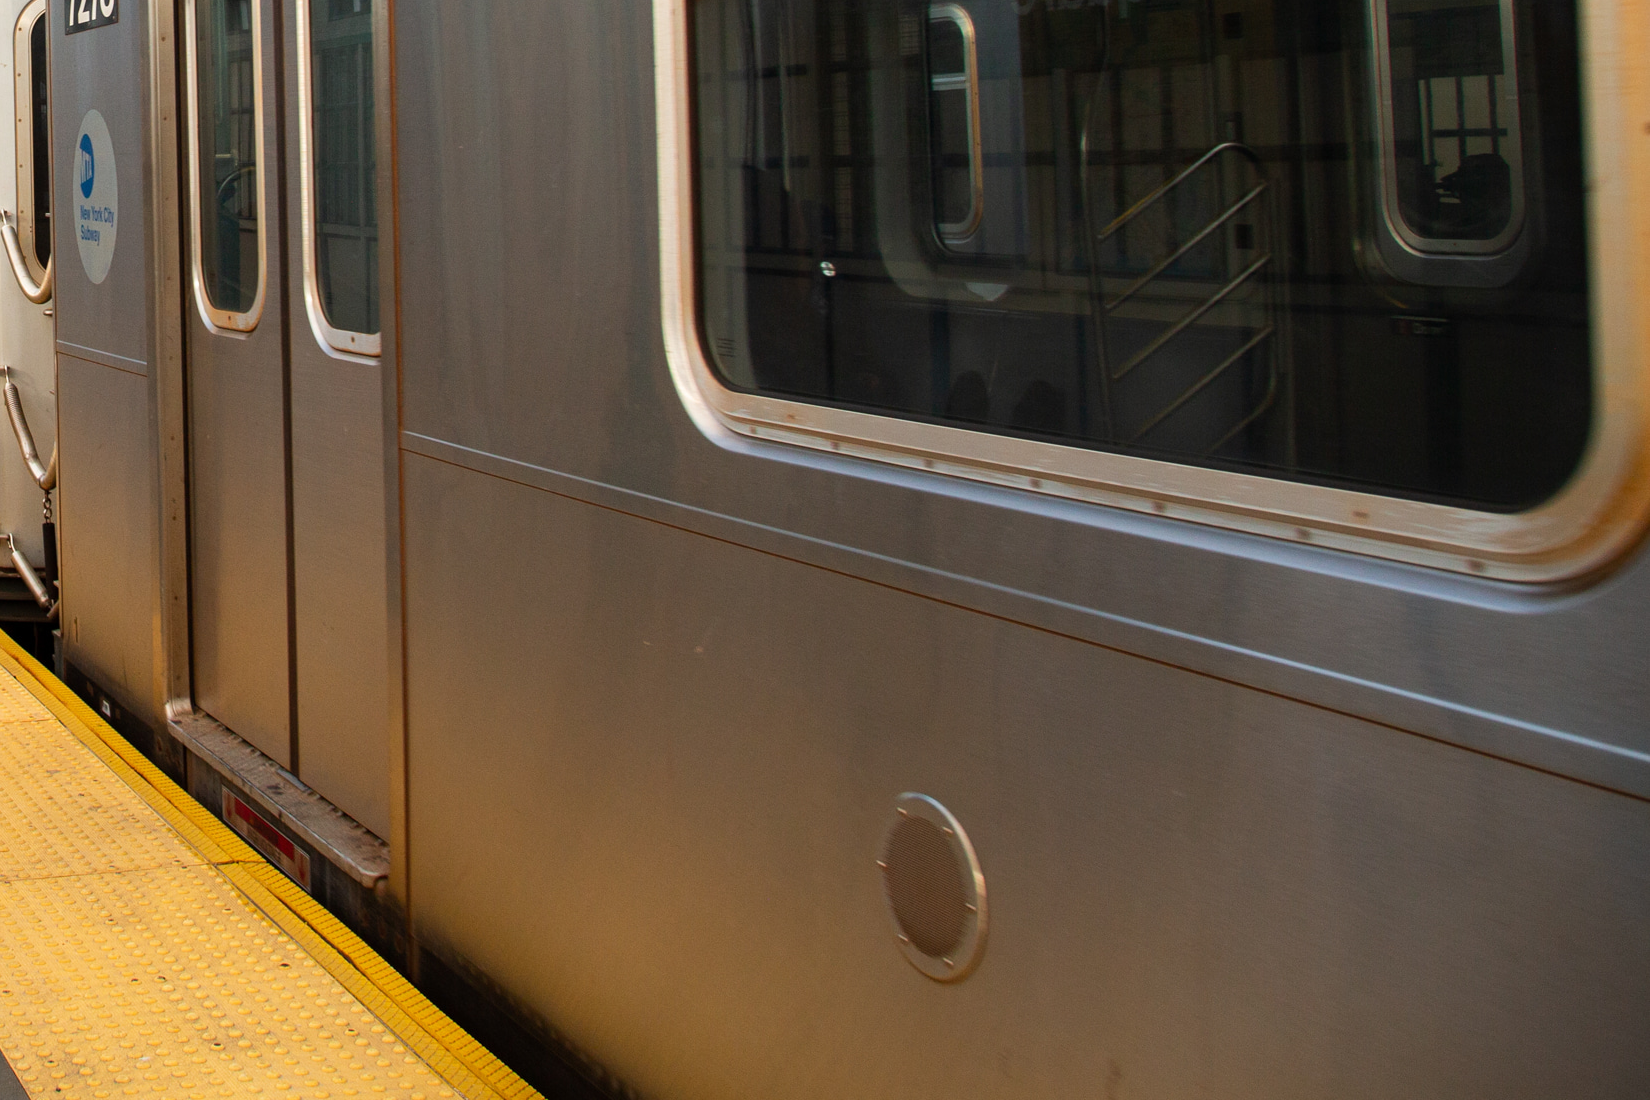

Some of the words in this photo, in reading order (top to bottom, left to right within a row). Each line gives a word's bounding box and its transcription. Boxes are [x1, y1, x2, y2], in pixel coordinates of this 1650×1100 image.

[80, 204, 91, 221] New
[91, 205, 103, 222] York
[104, 206, 114, 228] City
[81, 224, 100, 247] Subway
